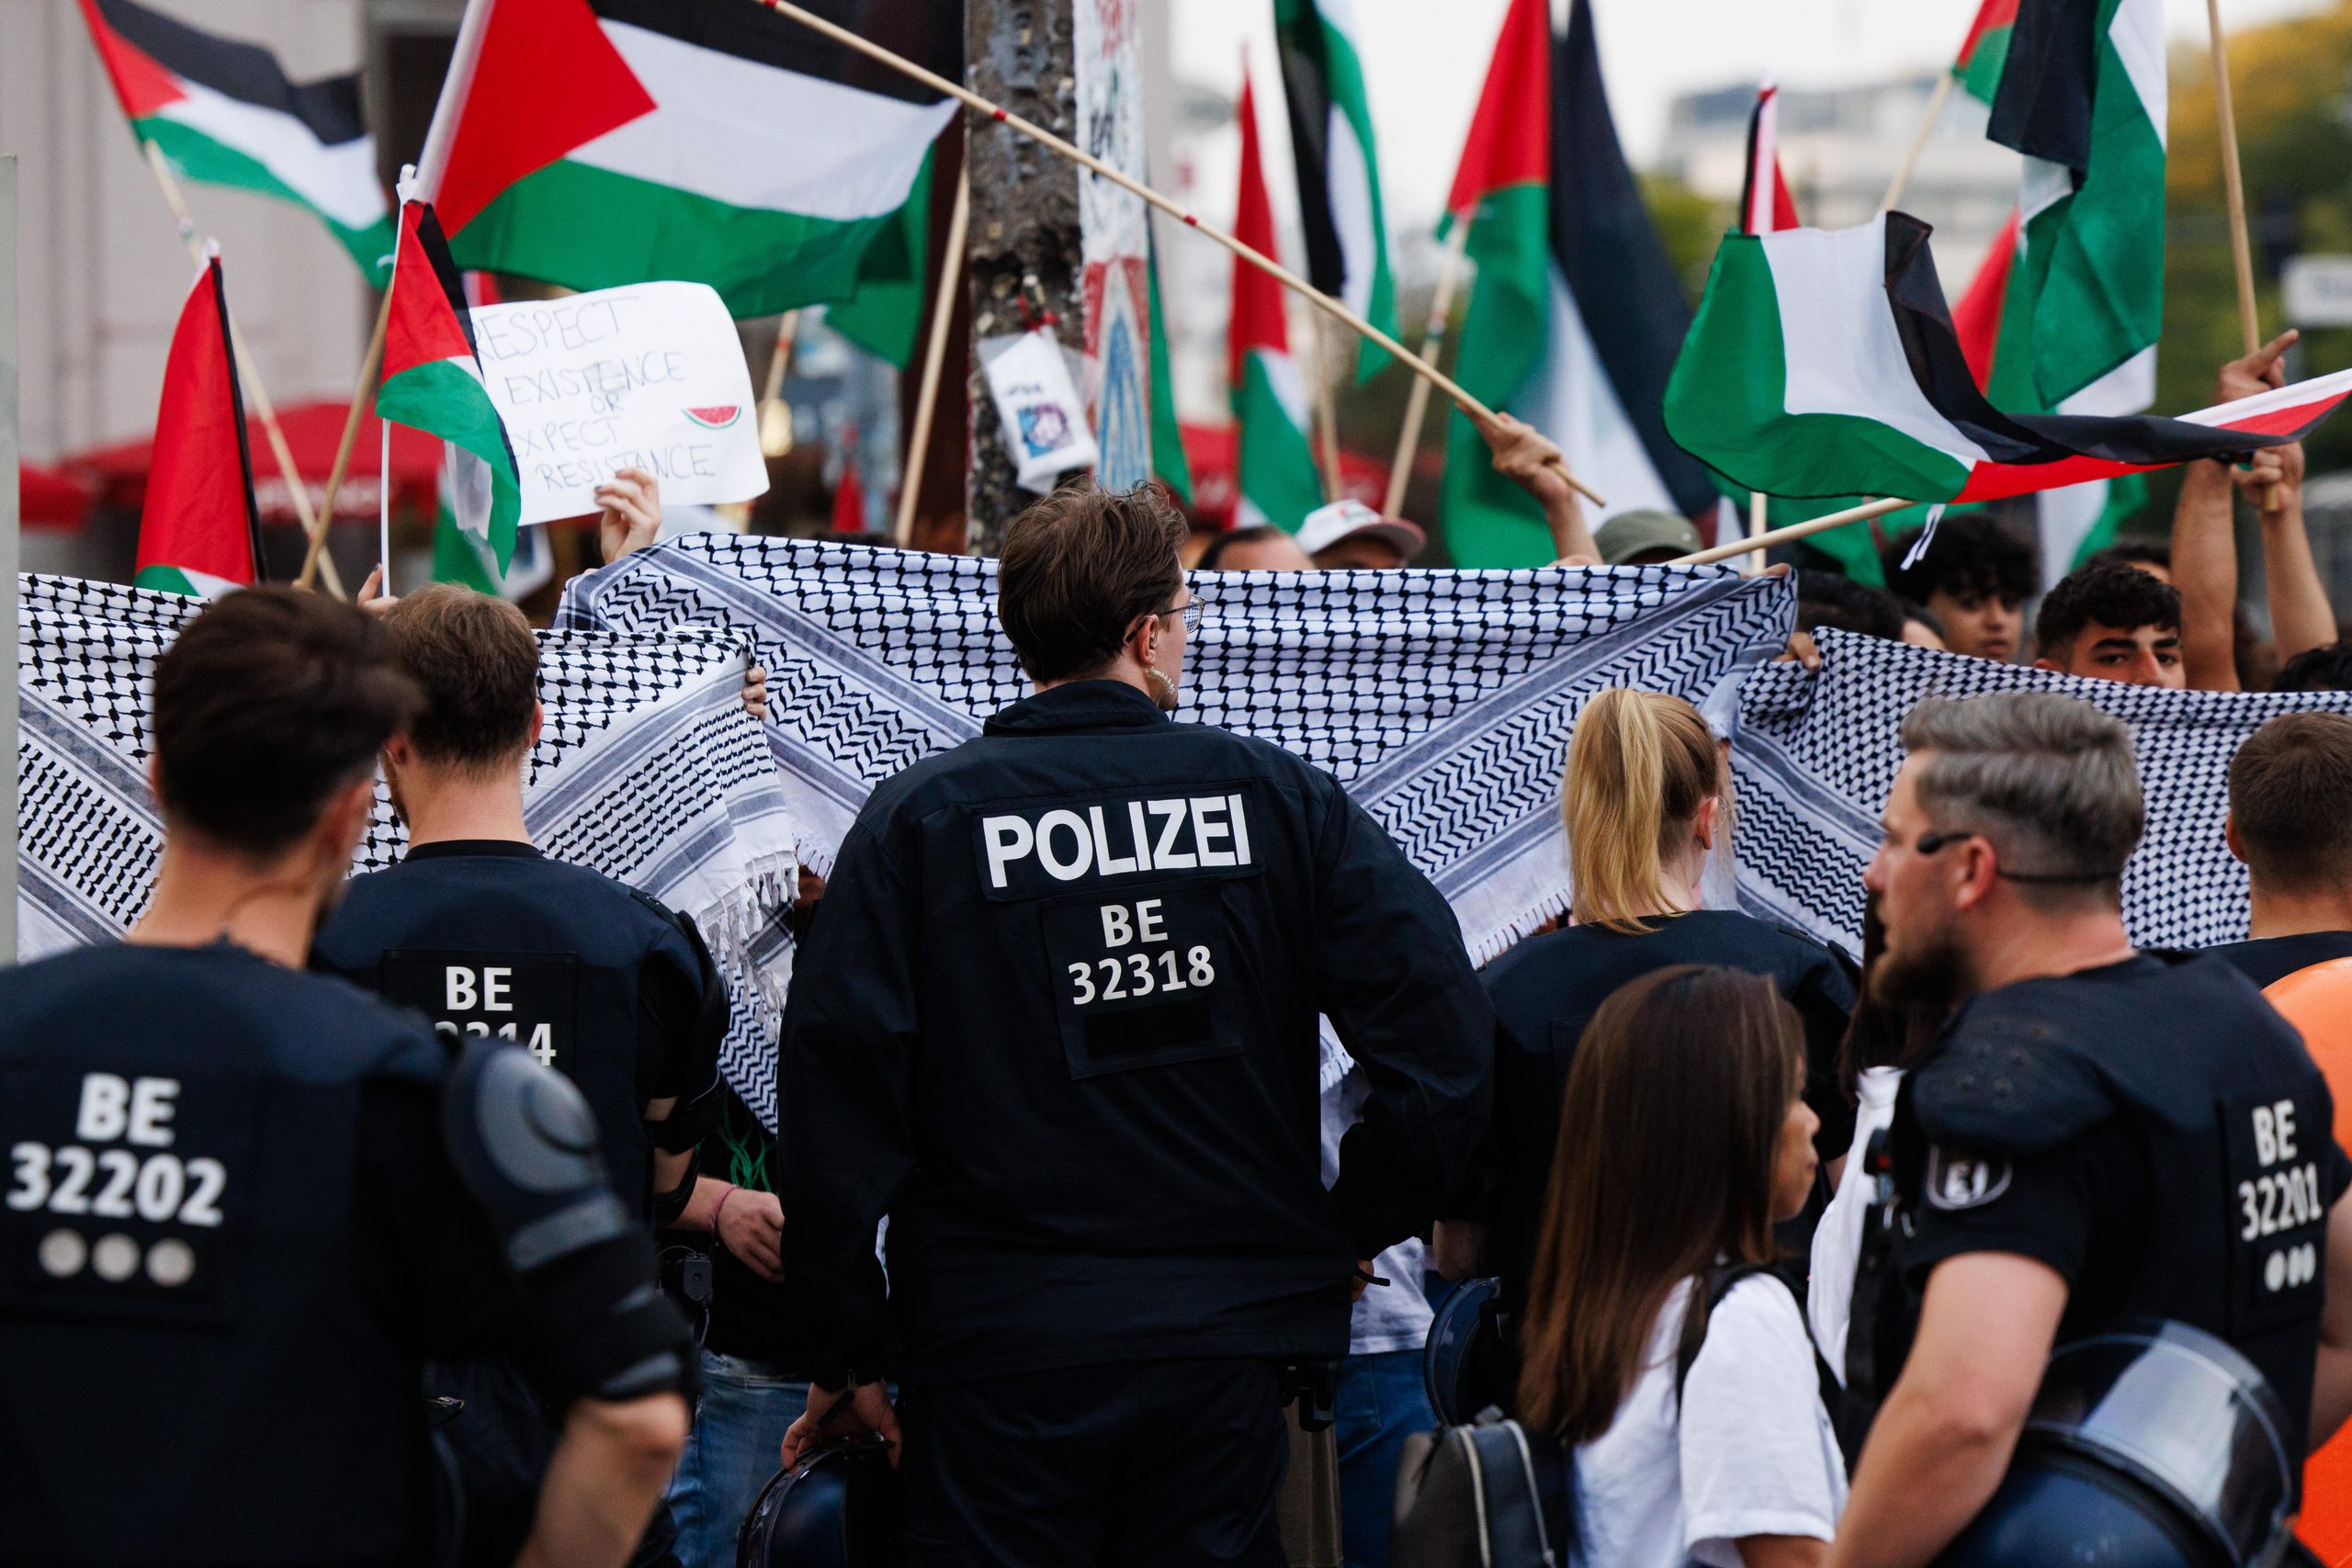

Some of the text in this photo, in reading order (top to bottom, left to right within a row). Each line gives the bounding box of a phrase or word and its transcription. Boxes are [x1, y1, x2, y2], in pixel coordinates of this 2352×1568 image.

[503, 351, 685, 405] EXISTENCE
[591, 394, 625, 414] OR
[514, 416, 622, 458] XPECT
[982, 794, 1251, 888] POLIZEI
[1101, 898, 1169, 948] BE
[446, 965, 514, 1011] BE
[1068, 945, 1216, 1005] 32318
[76, 1071, 181, 1148] BE
[2252, 1099, 2298, 1168] BE
[6, 1141, 228, 1227] 32202
[2237, 1161, 2323, 1242] 32201
